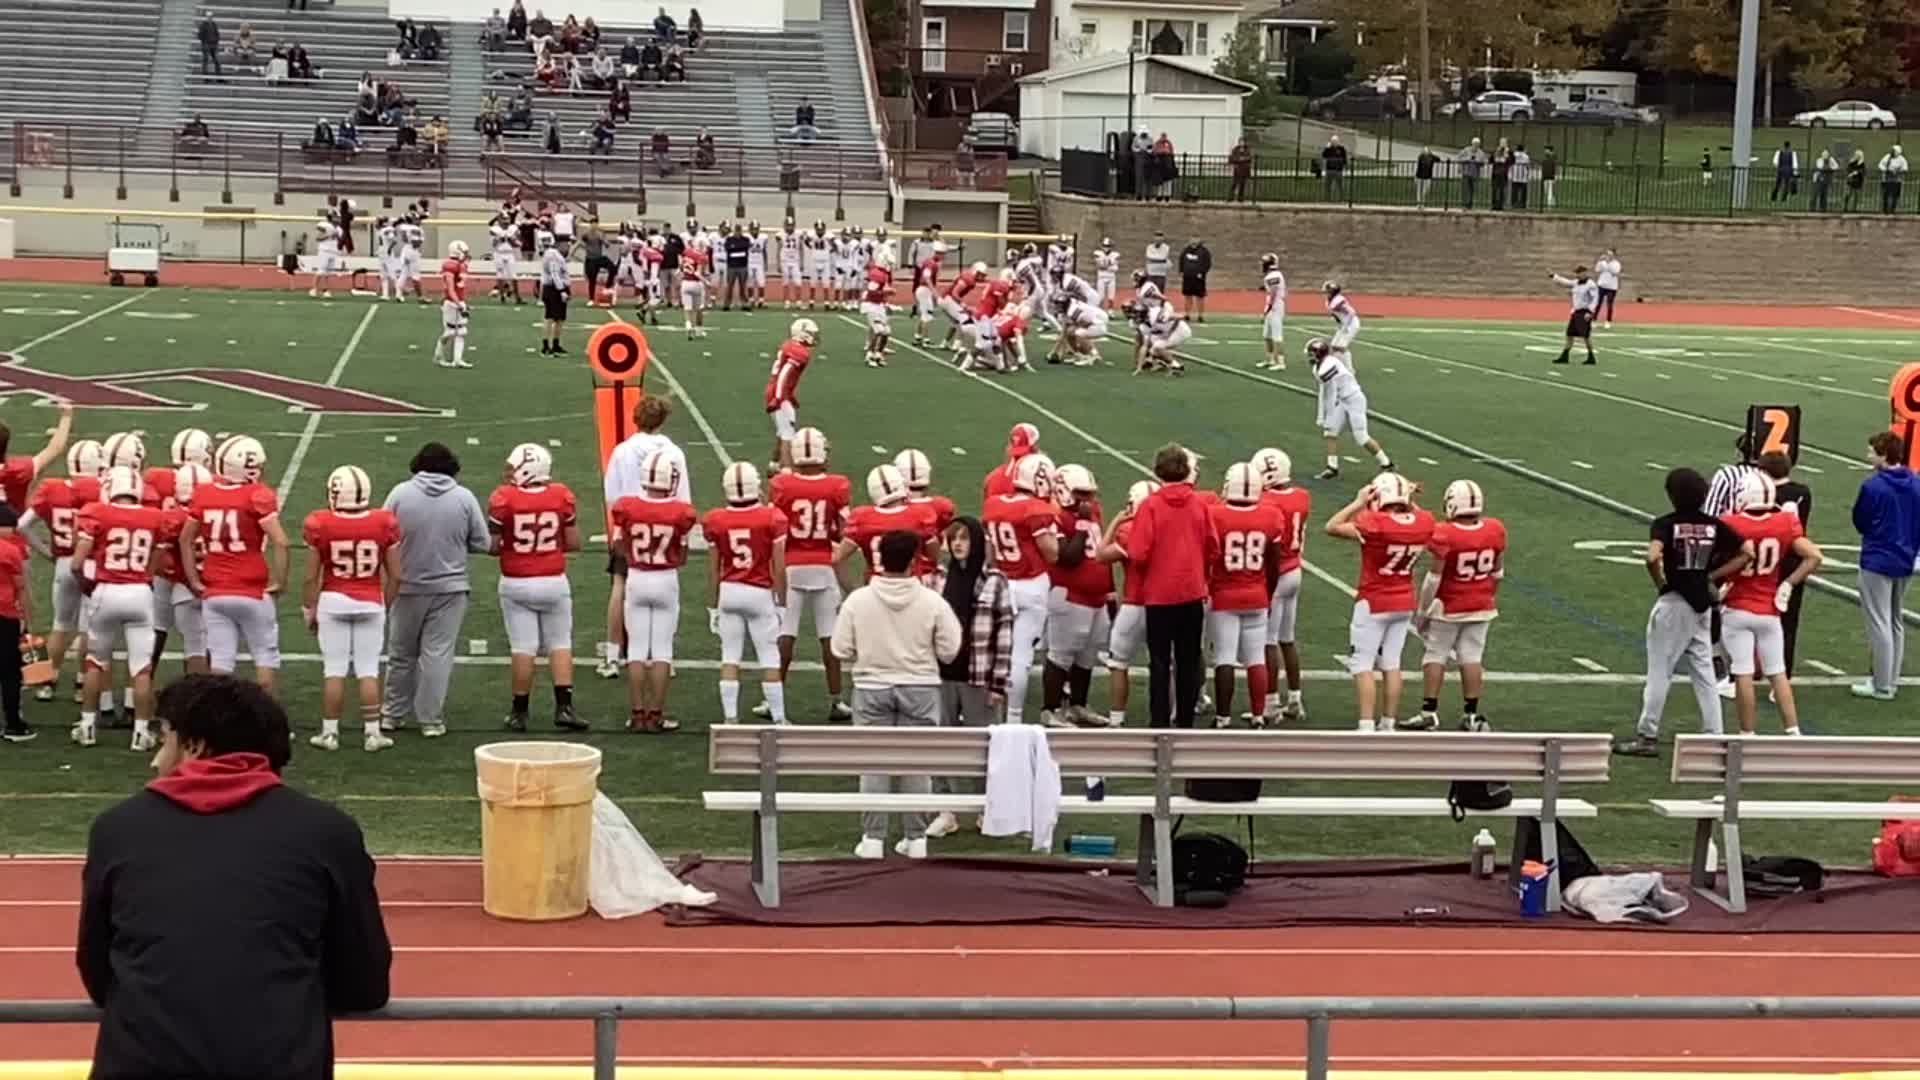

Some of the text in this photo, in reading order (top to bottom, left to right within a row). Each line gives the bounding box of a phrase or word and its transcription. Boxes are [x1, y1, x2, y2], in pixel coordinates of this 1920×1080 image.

[1761, 409, 1790, 455] 2
[203, 509, 247, 553] 71
[513, 511, 560, 555] 52
[791, 500, 829, 539] 31
[105, 527, 153, 572] 28
[330, 539, 380, 579] 58
[630, 523, 675, 565] 27
[728, 528, 753, 569] 5
[987, 520, 1022, 562] 19
[1224, 530, 1267, 572] 68
[1378, 543, 1424, 576] 77
[1455, 548, 1495, 582] 59
